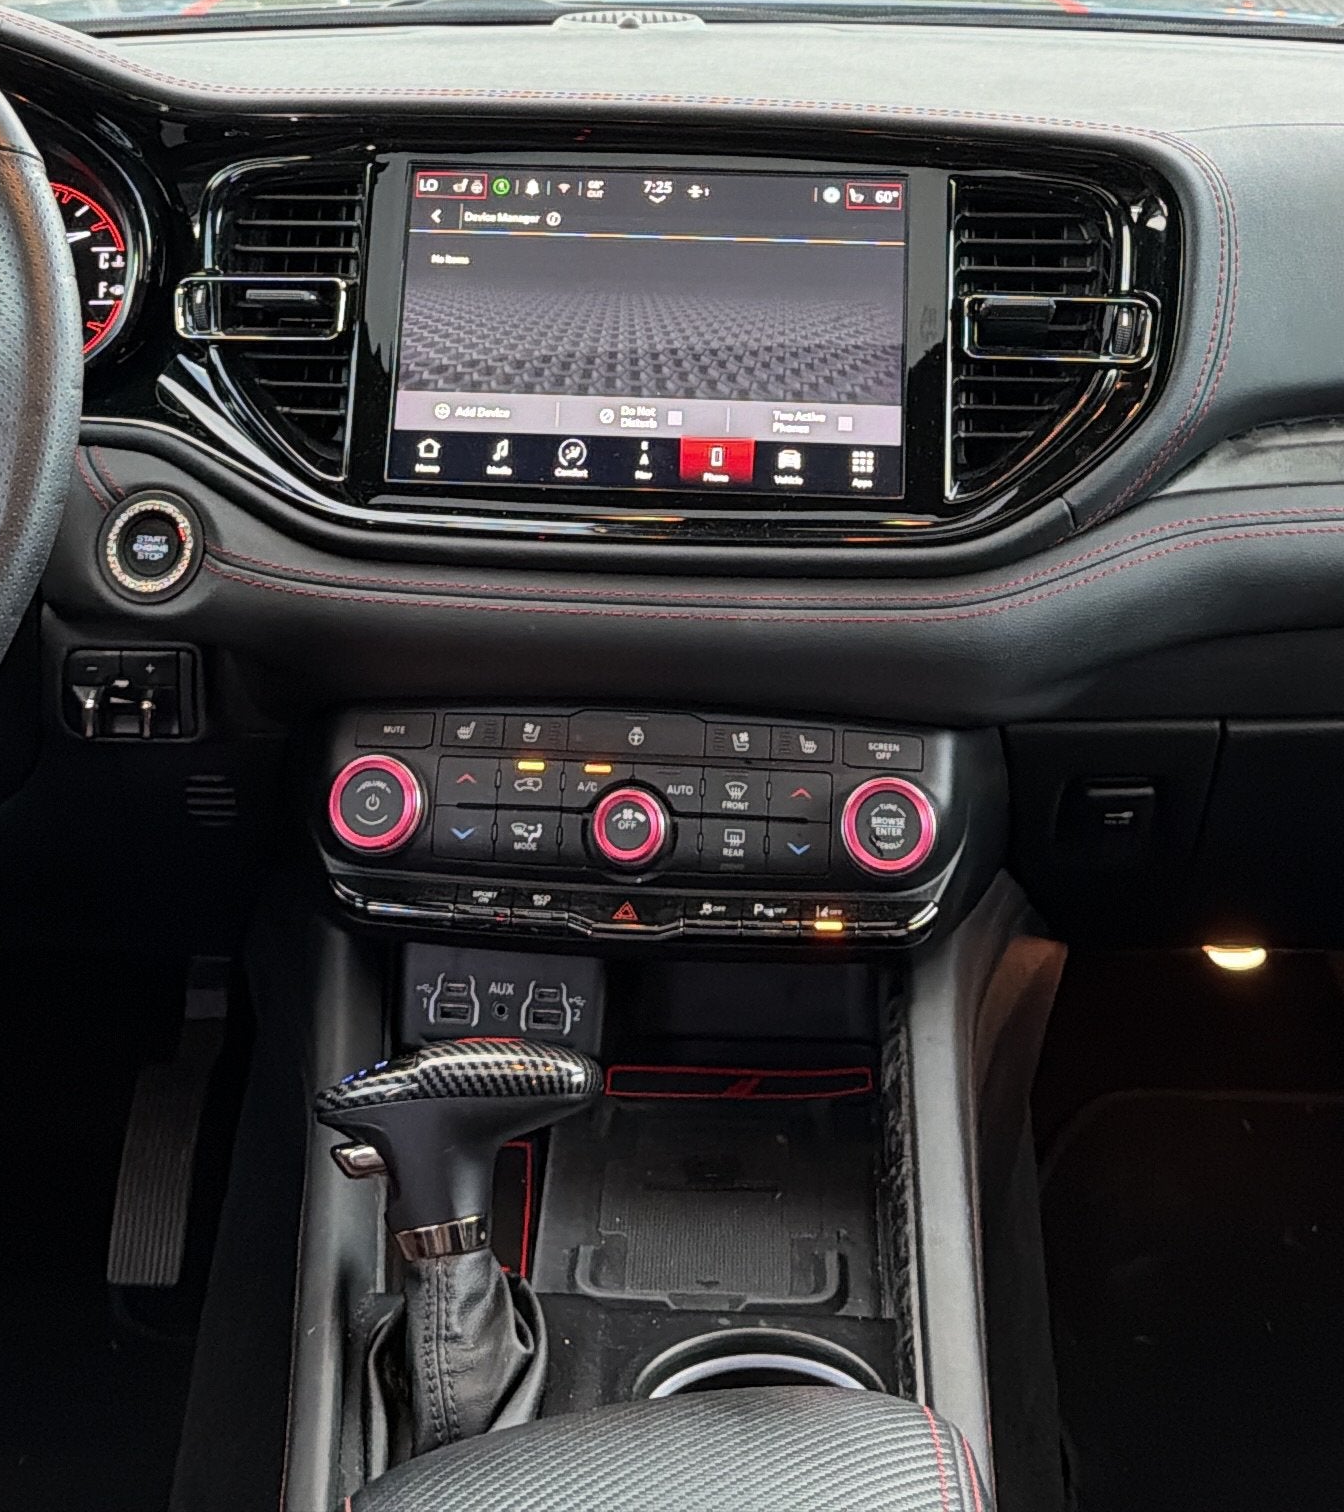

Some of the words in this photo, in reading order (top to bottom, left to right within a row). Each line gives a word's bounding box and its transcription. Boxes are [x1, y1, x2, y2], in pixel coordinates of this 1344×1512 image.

[419, 178, 439, 193] LO
[643, 180, 673, 194] 7:25
[874, 190, 899, 204] 60°
[464, 211, 496, 223] Device
[497, 212, 542, 225] Manager
[99, 252, 110, 270] C
[430, 253, 445, 265] No
[98, 281, 109, 299] F
[455, 407, 476, 418] Add
[477, 408, 511, 419] Device
[620, 406, 636, 416] Do
[637, 406, 656, 417] Not
[772, 410, 794, 422] Two
[795, 411, 826, 423] Active
[415, 463, 441, 474] Home
[702, 472, 730, 484] Phone
[851, 477, 874, 490] Apps
[136, 534, 168, 543] START
[133, 543, 169, 553] ENGINE
[137, 552, 165, 561] STOP
[383, 725, 406, 735] MUTE
[867, 741, 900, 752] SCREEN
[875, 751, 892, 761] OFF
[577, 781, 598, 793] A/C
[666, 784, 694, 796] AUTO
[721, 800, 750, 811] FRONT
[617, 819, 638, 831] OFF
[871, 816, 906, 826] BROWSE
[875, 826, 903, 837] ENTER
[513, 841, 538, 851] MODE
[722, 847, 745, 858] REAR
[472, 890, 499, 900] SPORT
[488, 981, 515, 996] AUX
[422, 997, 428, 1010] 1
[573, 1008, 581, 1022] 2
